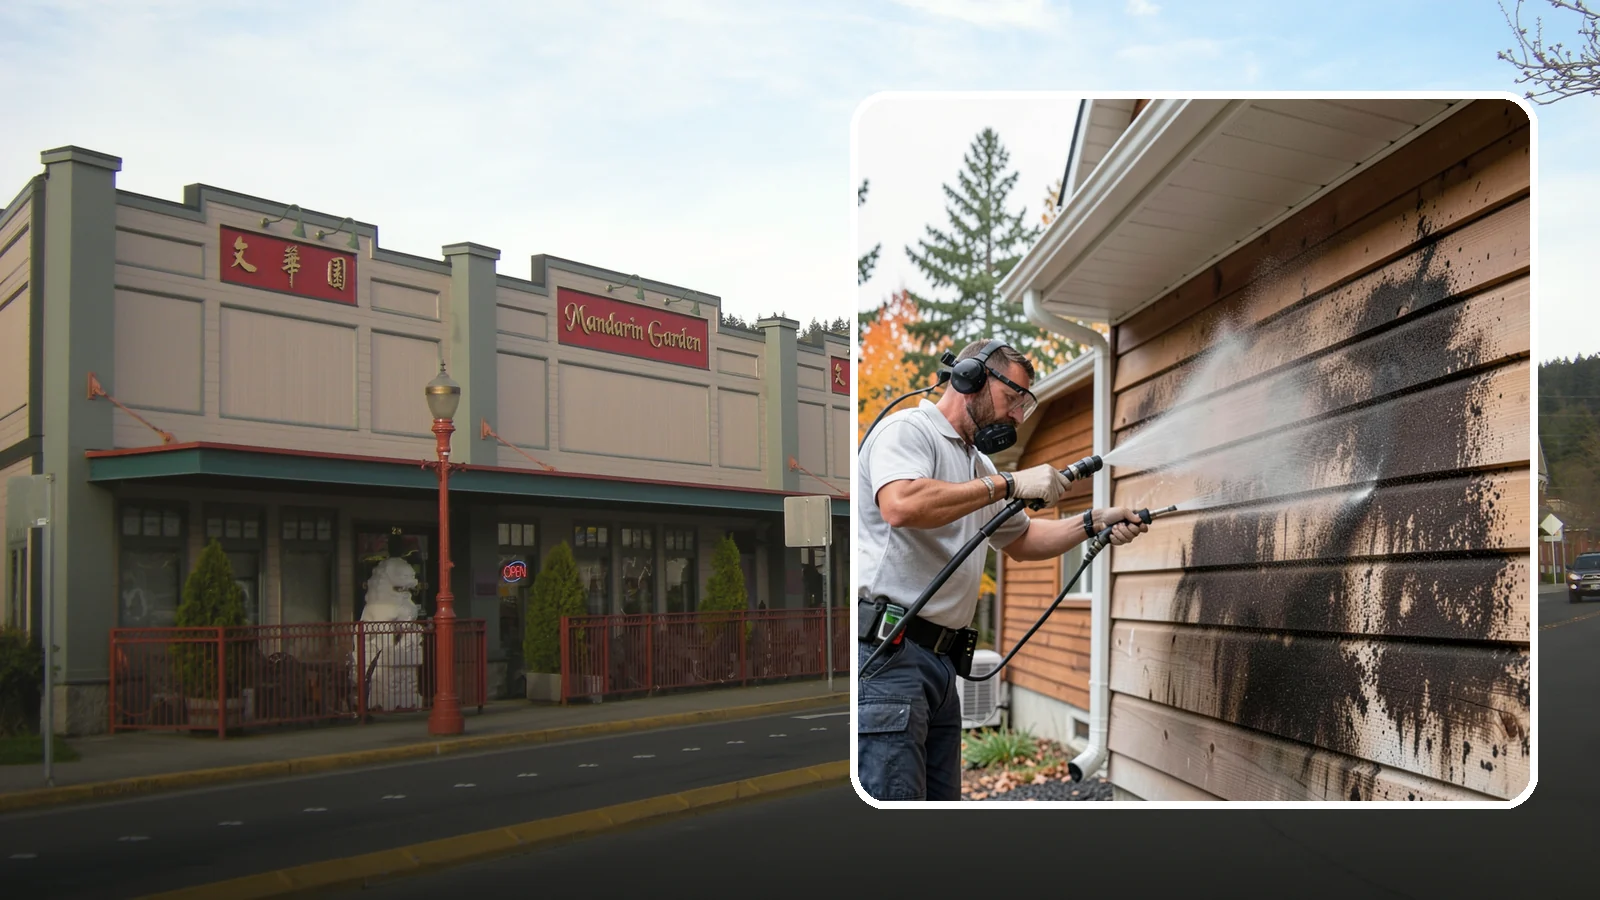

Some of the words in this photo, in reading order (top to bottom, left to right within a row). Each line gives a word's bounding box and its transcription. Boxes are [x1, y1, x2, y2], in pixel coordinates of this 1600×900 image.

[231, 236, 346, 290] 文華園
[565, 302, 644, 340] Mandarin
[648, 320, 701, 352] Garden
[835, 363, 846, 386] 文
[503, 565, 527, 578] OPEN
